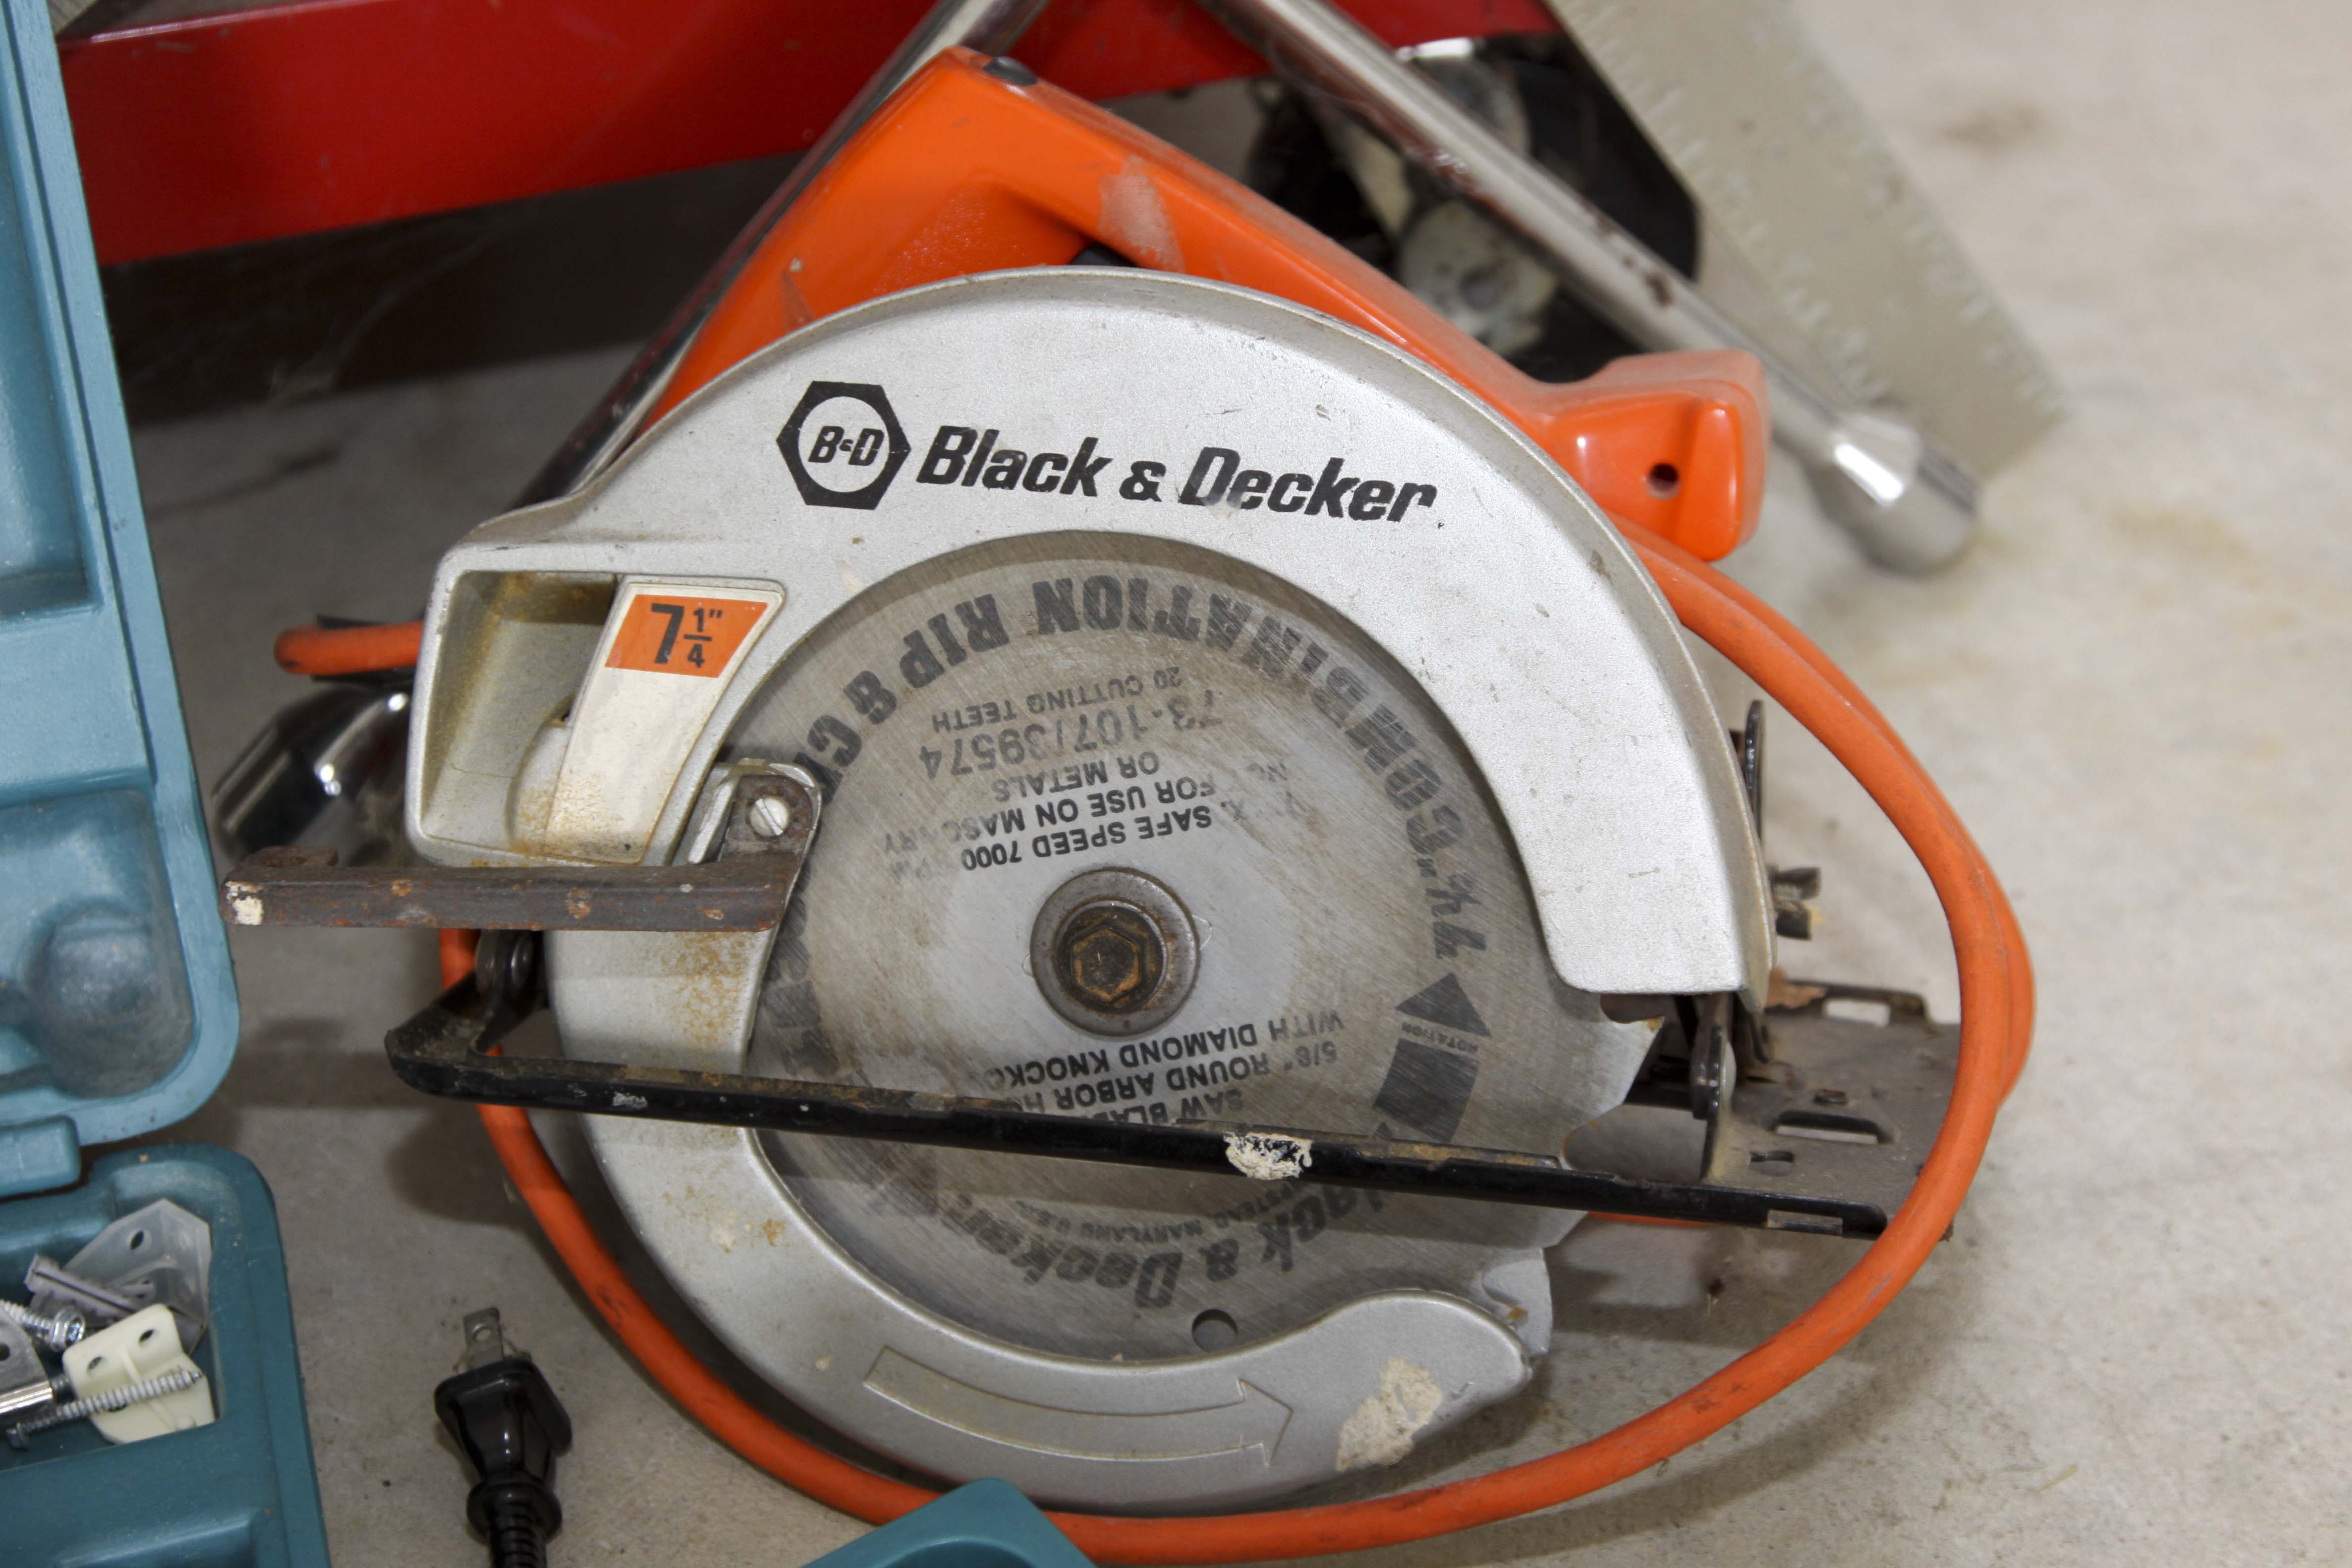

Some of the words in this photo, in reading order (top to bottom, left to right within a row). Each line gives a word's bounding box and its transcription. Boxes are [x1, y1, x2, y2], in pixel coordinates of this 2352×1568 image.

[916, 425, 1115, 498] Black
[1119, 460, 1167, 502] &
[1178, 446, 1438, 523] Decker
[898, 593, 1010, 688] RIP
[1026, 674, 1144, 715] CUTTING
[1153, 665, 1185, 690] 20
[843, 670, 897, 725] &
[931, 699, 1016, 734] TEETH
[1031, 574, 1465, 855] COMBINATION
[994, 759, 1109, 804] METALS
[1117, 750, 1160, 778] OR
[1090, 784, 1146, 818] USE
[1158, 776, 1217, 804] FOR
[1035, 798, 1079, 827] ON
[1137, 805, 1212, 841] SAFE
[960, 840, 1023, 871] 7000
[1031, 820, 1127, 859] SPEED
[1269, 1008, 1345, 1042] WITH
[1119, 1023, 1257, 1068] DIAMOND
[1054, 1072, 1154, 1110] ARBOR
[1166, 1053, 1269, 1092] ROUND
[1093, 1102, 1170, 1124] BLA
[1180, 1088, 1244, 1120] SAW
[939, 1206, 1183, 1309] Decker
[1198, 1238, 1240, 1282] &
